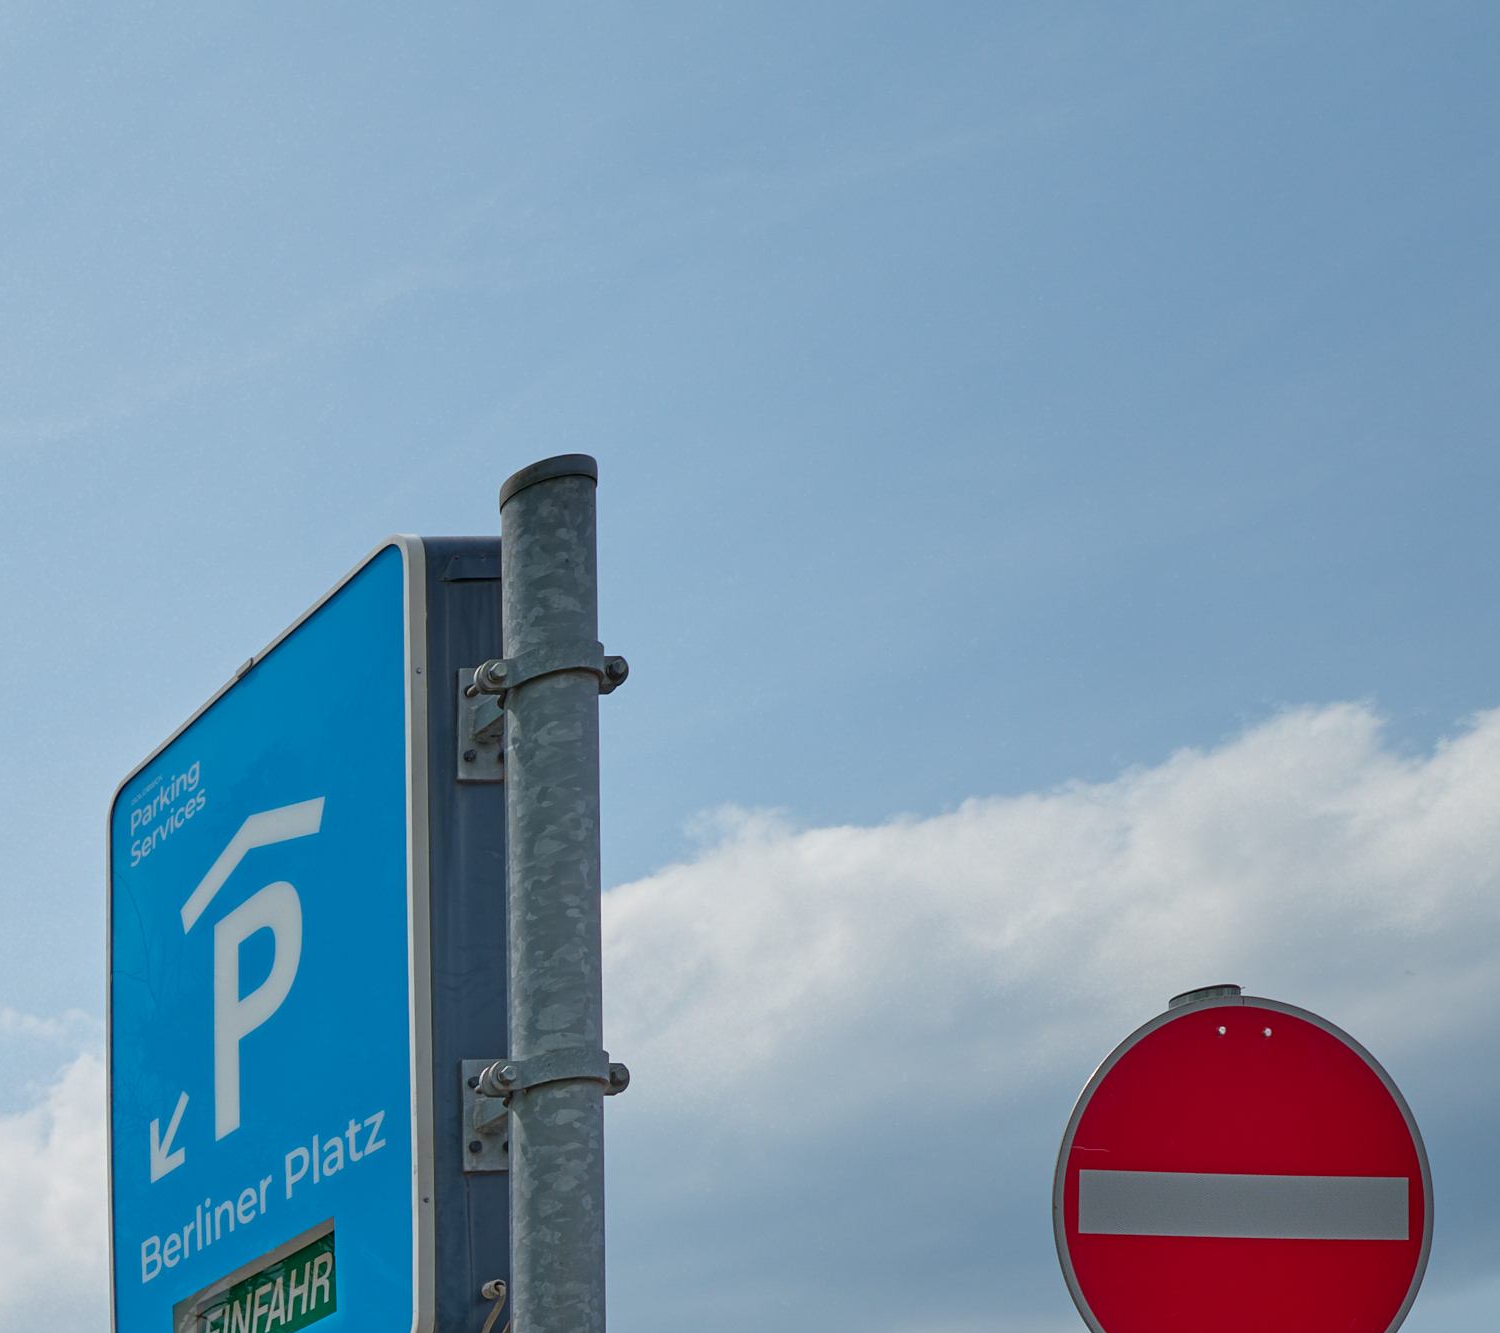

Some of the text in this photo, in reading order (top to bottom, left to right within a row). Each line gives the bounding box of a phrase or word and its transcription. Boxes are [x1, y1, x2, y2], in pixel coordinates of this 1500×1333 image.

[130, 760, 200, 837] Parking
[130, 788, 206, 868] Services
[141, 1109, 386, 1284] Berliner Platz
